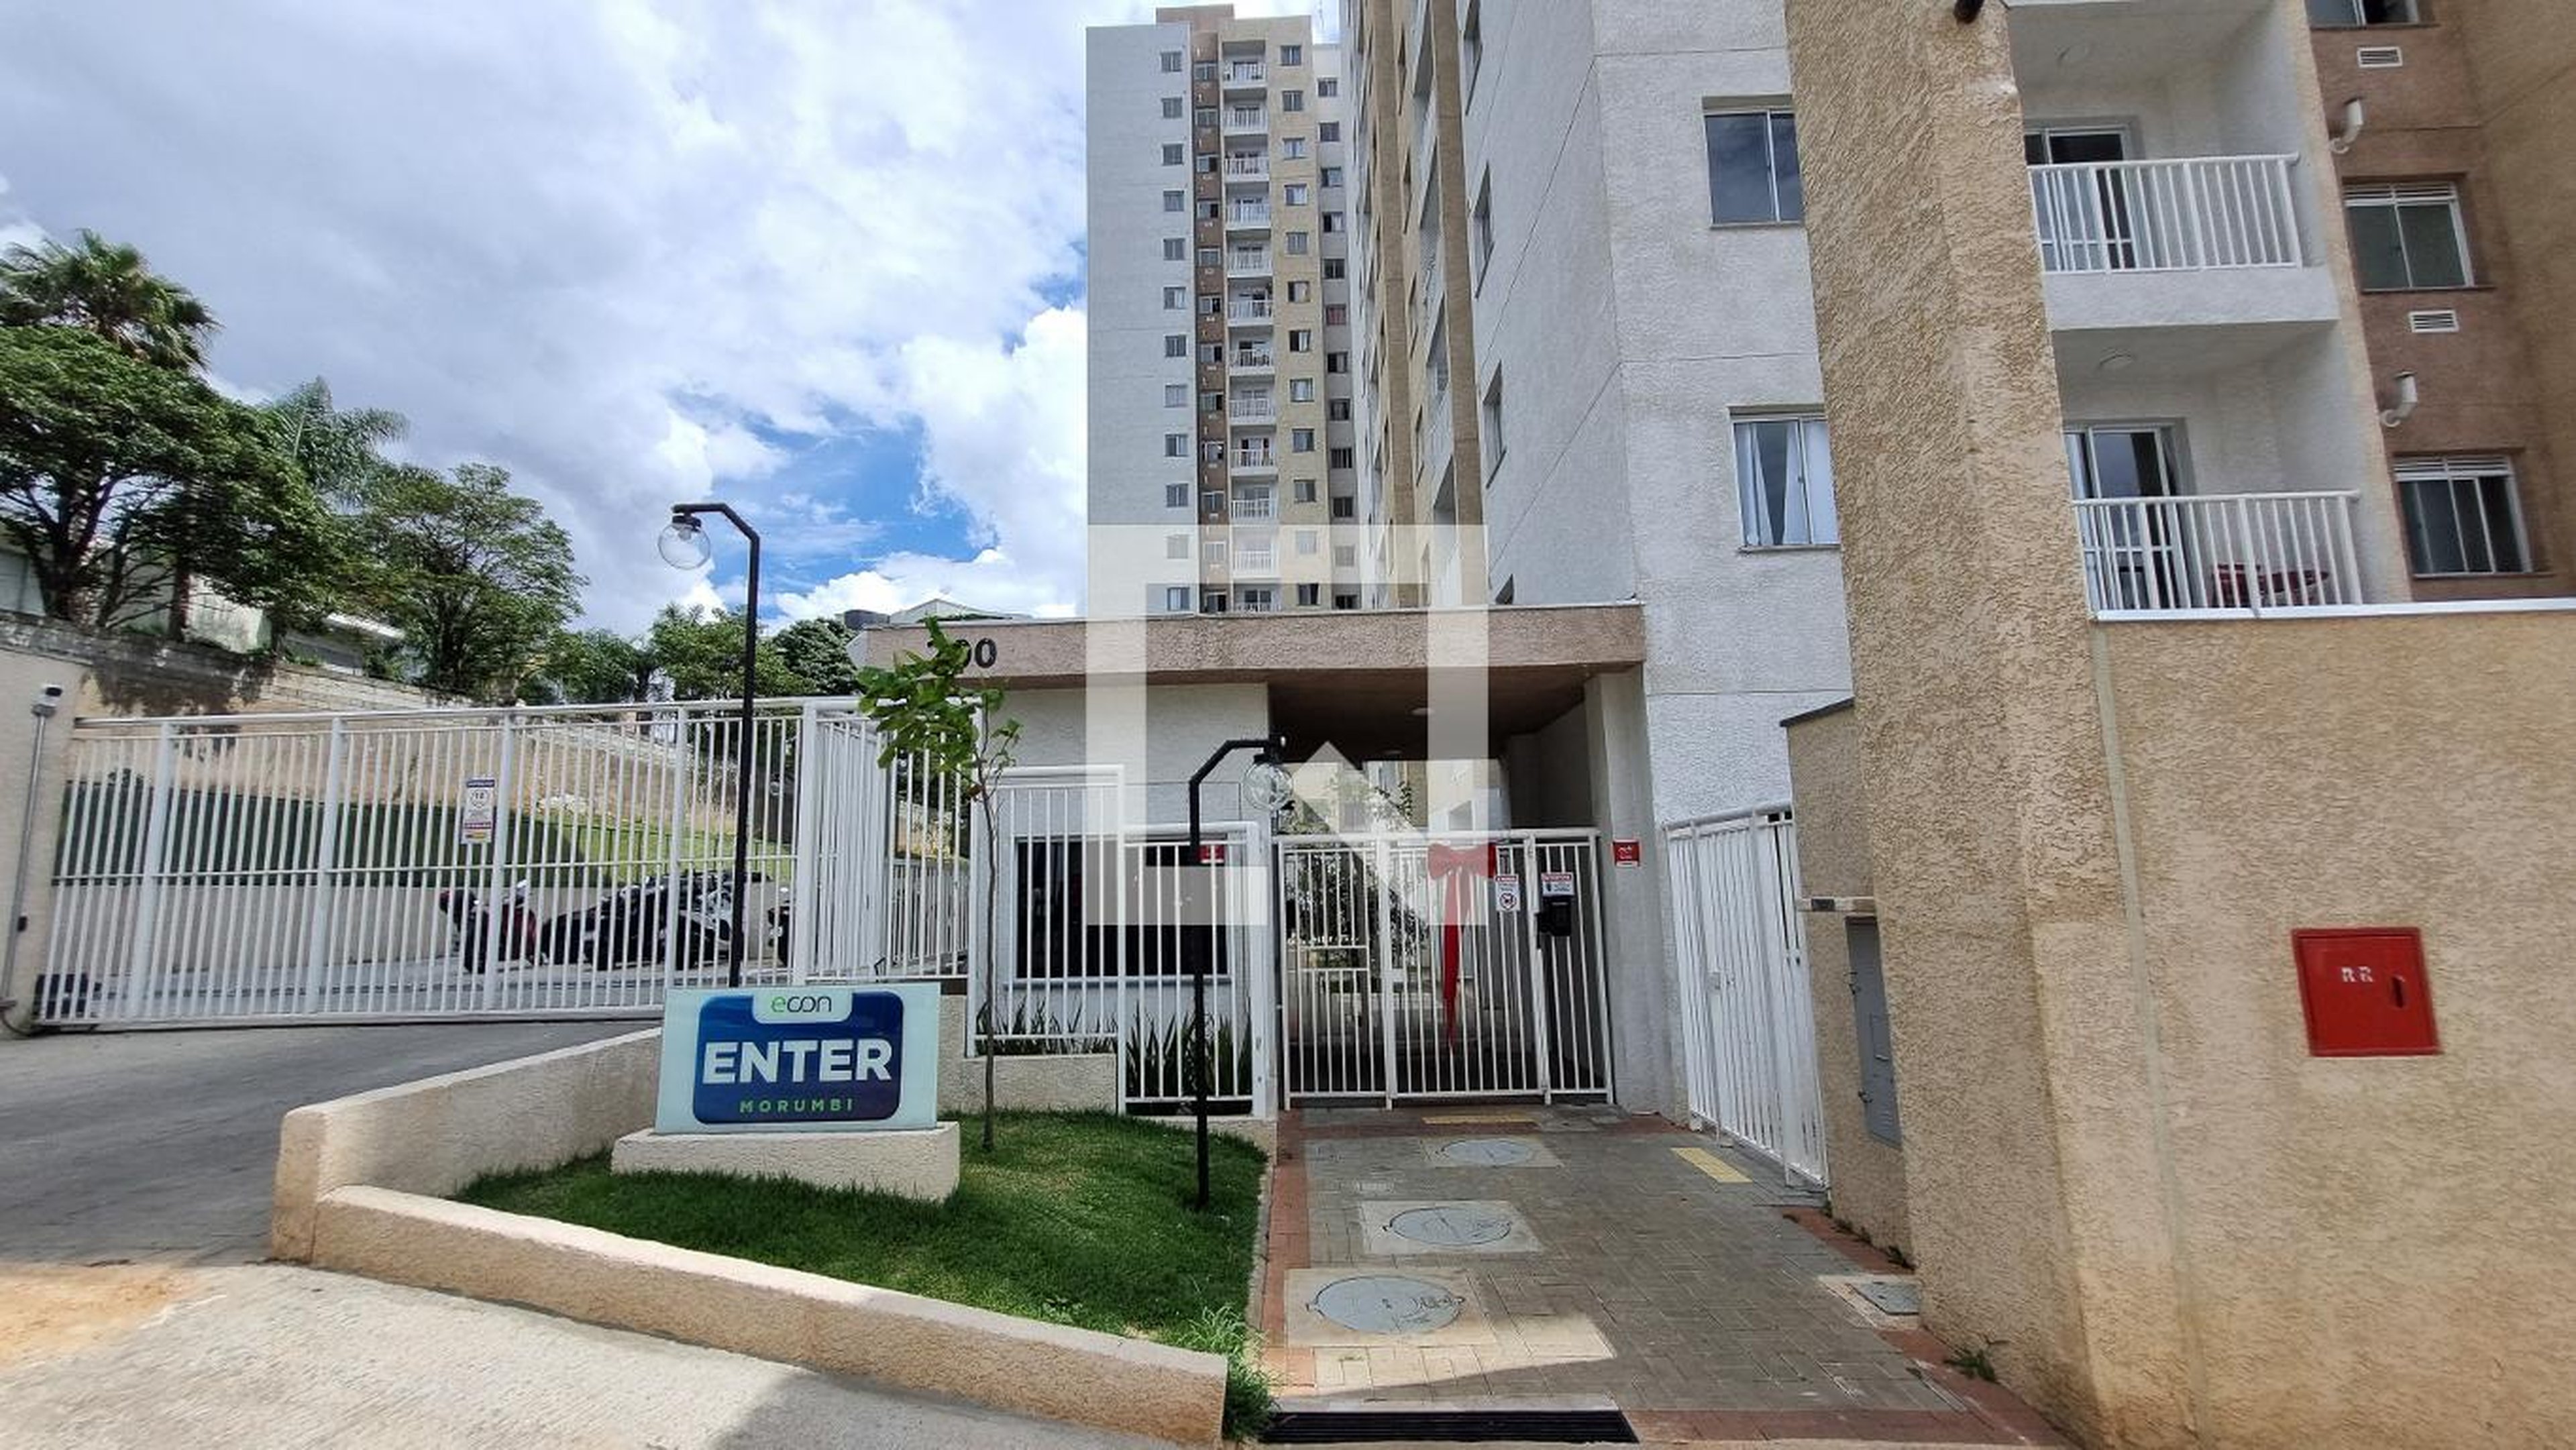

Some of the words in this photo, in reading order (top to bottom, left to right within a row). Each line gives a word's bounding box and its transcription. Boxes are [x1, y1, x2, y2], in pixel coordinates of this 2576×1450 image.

[771, 995, 832, 1013] econ
[702, 1039, 892, 1084] ENTER
[739, 1098, 853, 1113] MORUMBI
